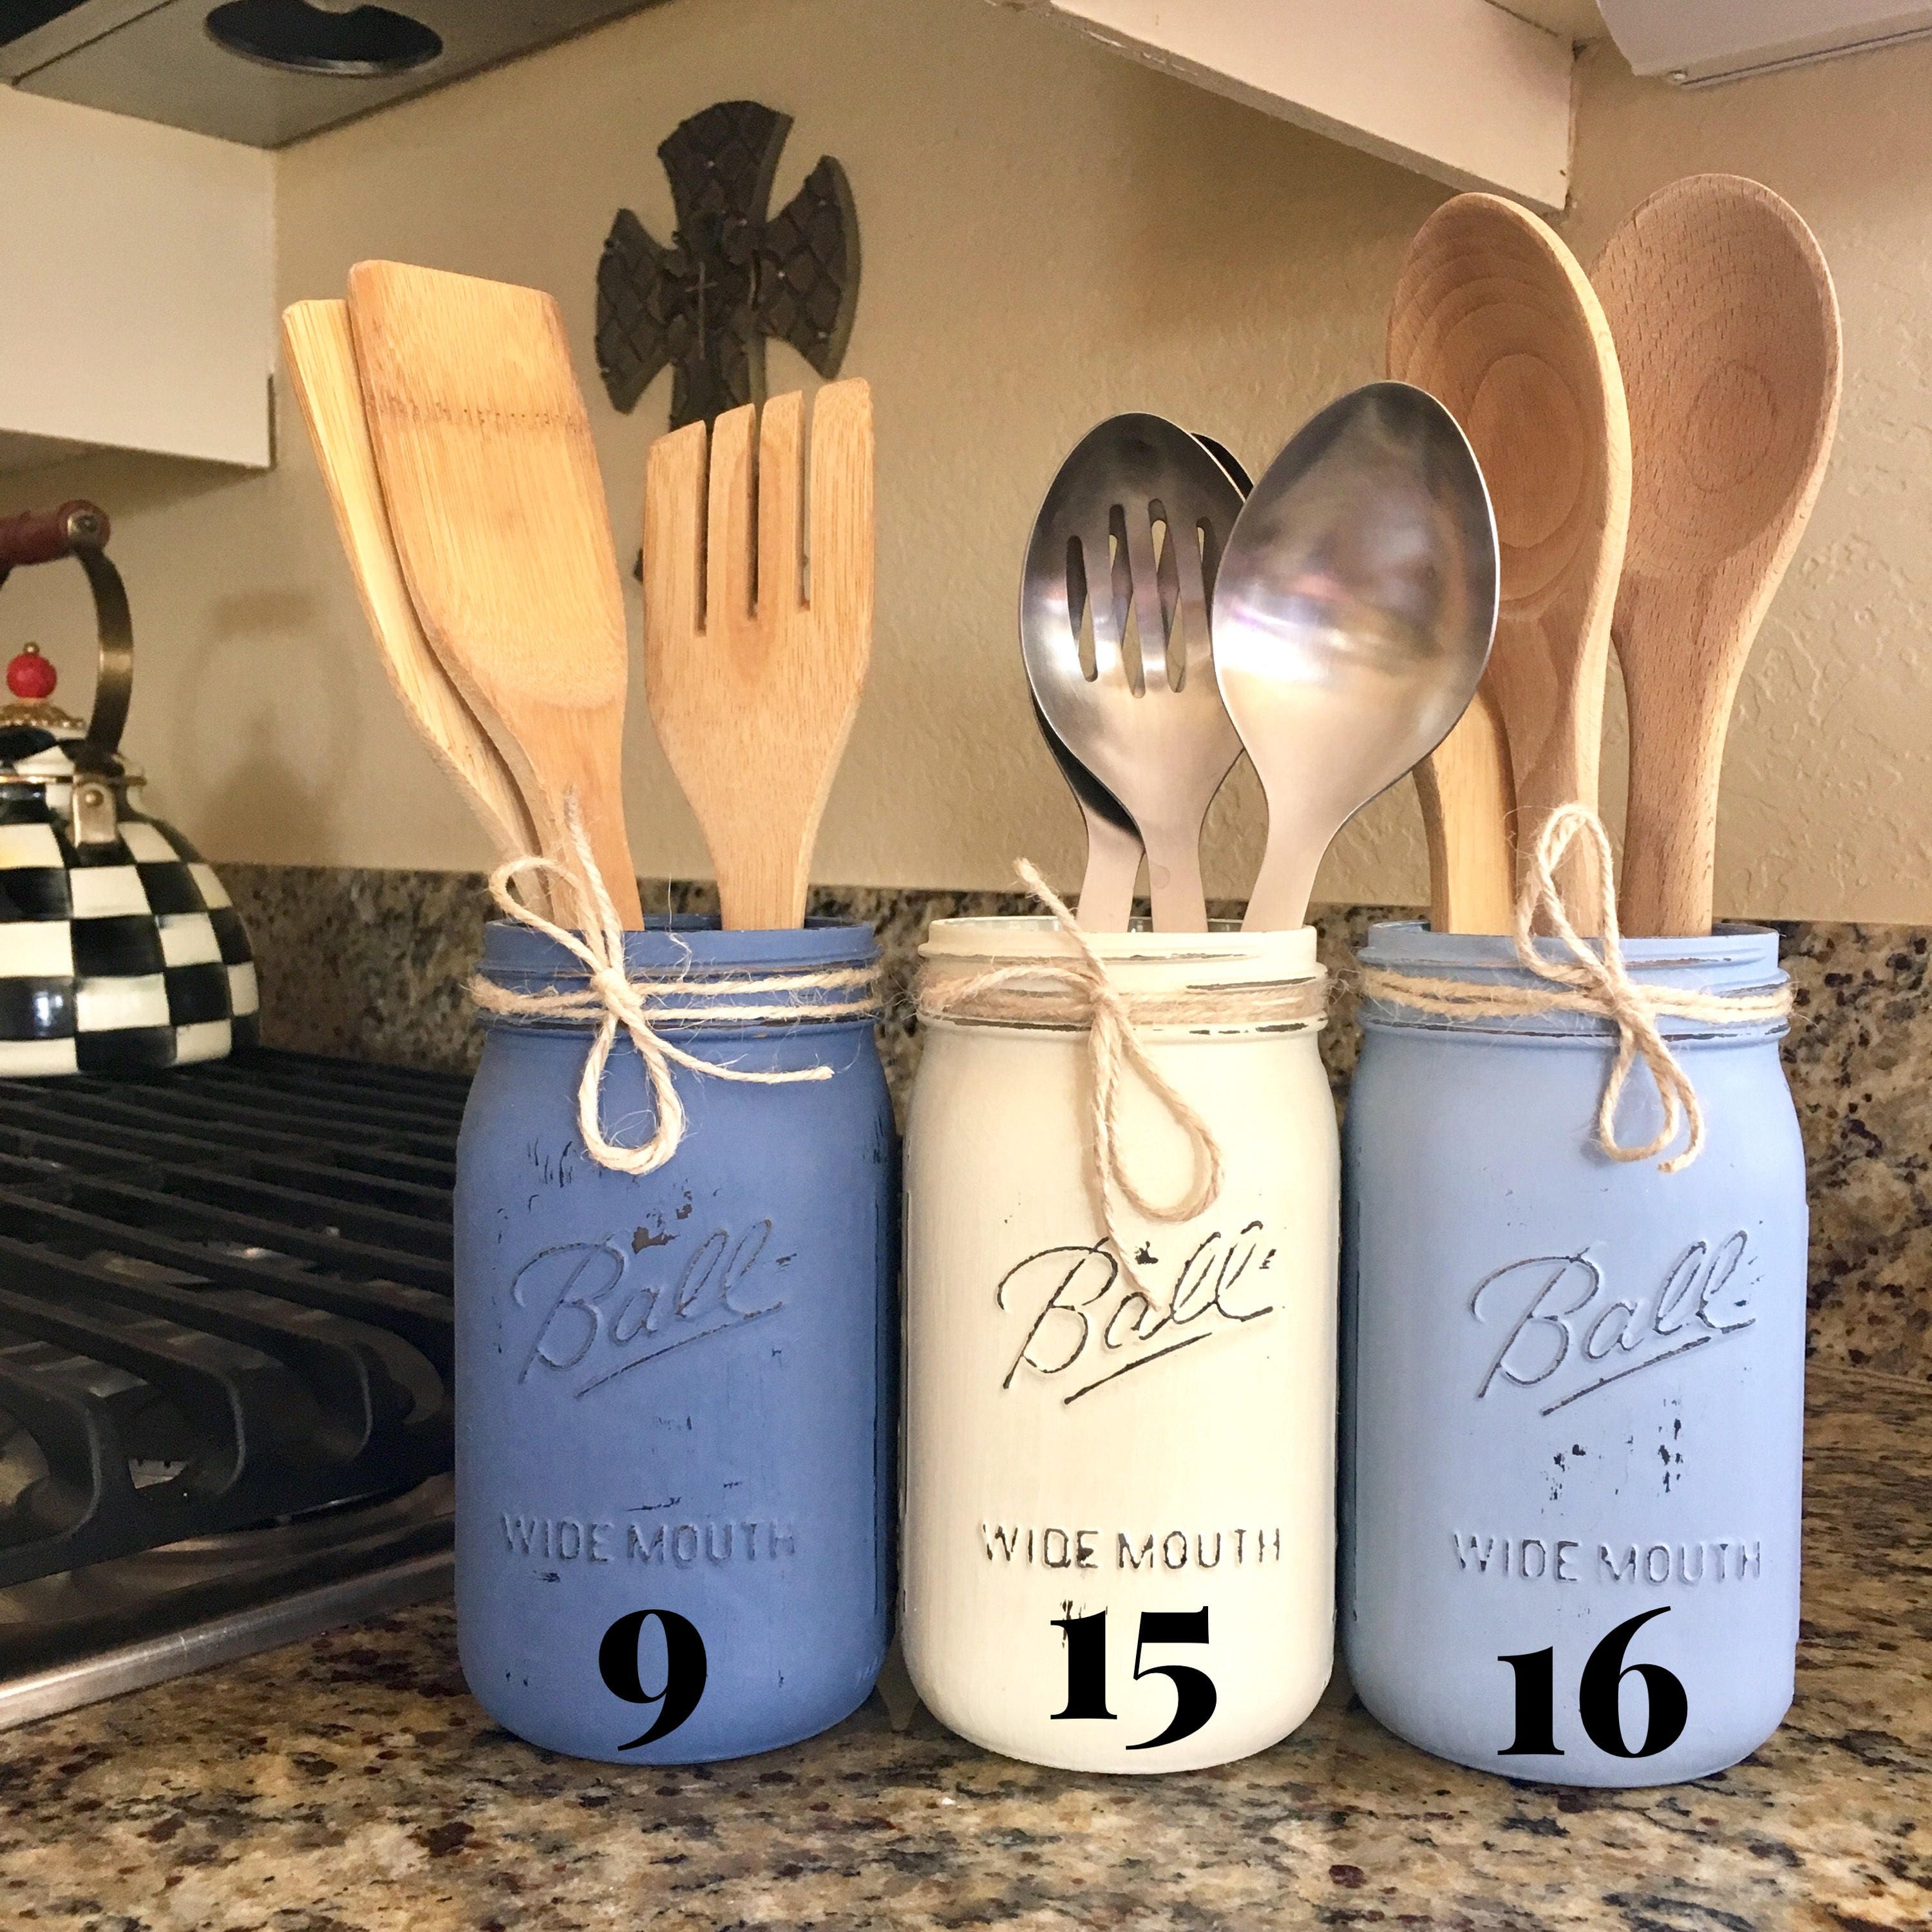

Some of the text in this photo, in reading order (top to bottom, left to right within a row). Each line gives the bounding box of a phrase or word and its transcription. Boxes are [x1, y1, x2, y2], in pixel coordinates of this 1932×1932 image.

[513, 1218, 783, 1385] Ball
[996, 1220, 1274, 1390] Ball
[1470, 1229, 1757, 1399] Ball
[501, 1513, 798, 1568] WIDE MOUTH
[982, 1521, 1281, 1569] WIDE MOUTH
[1454, 1530, 1761, 1585] WIDE MOUTH
